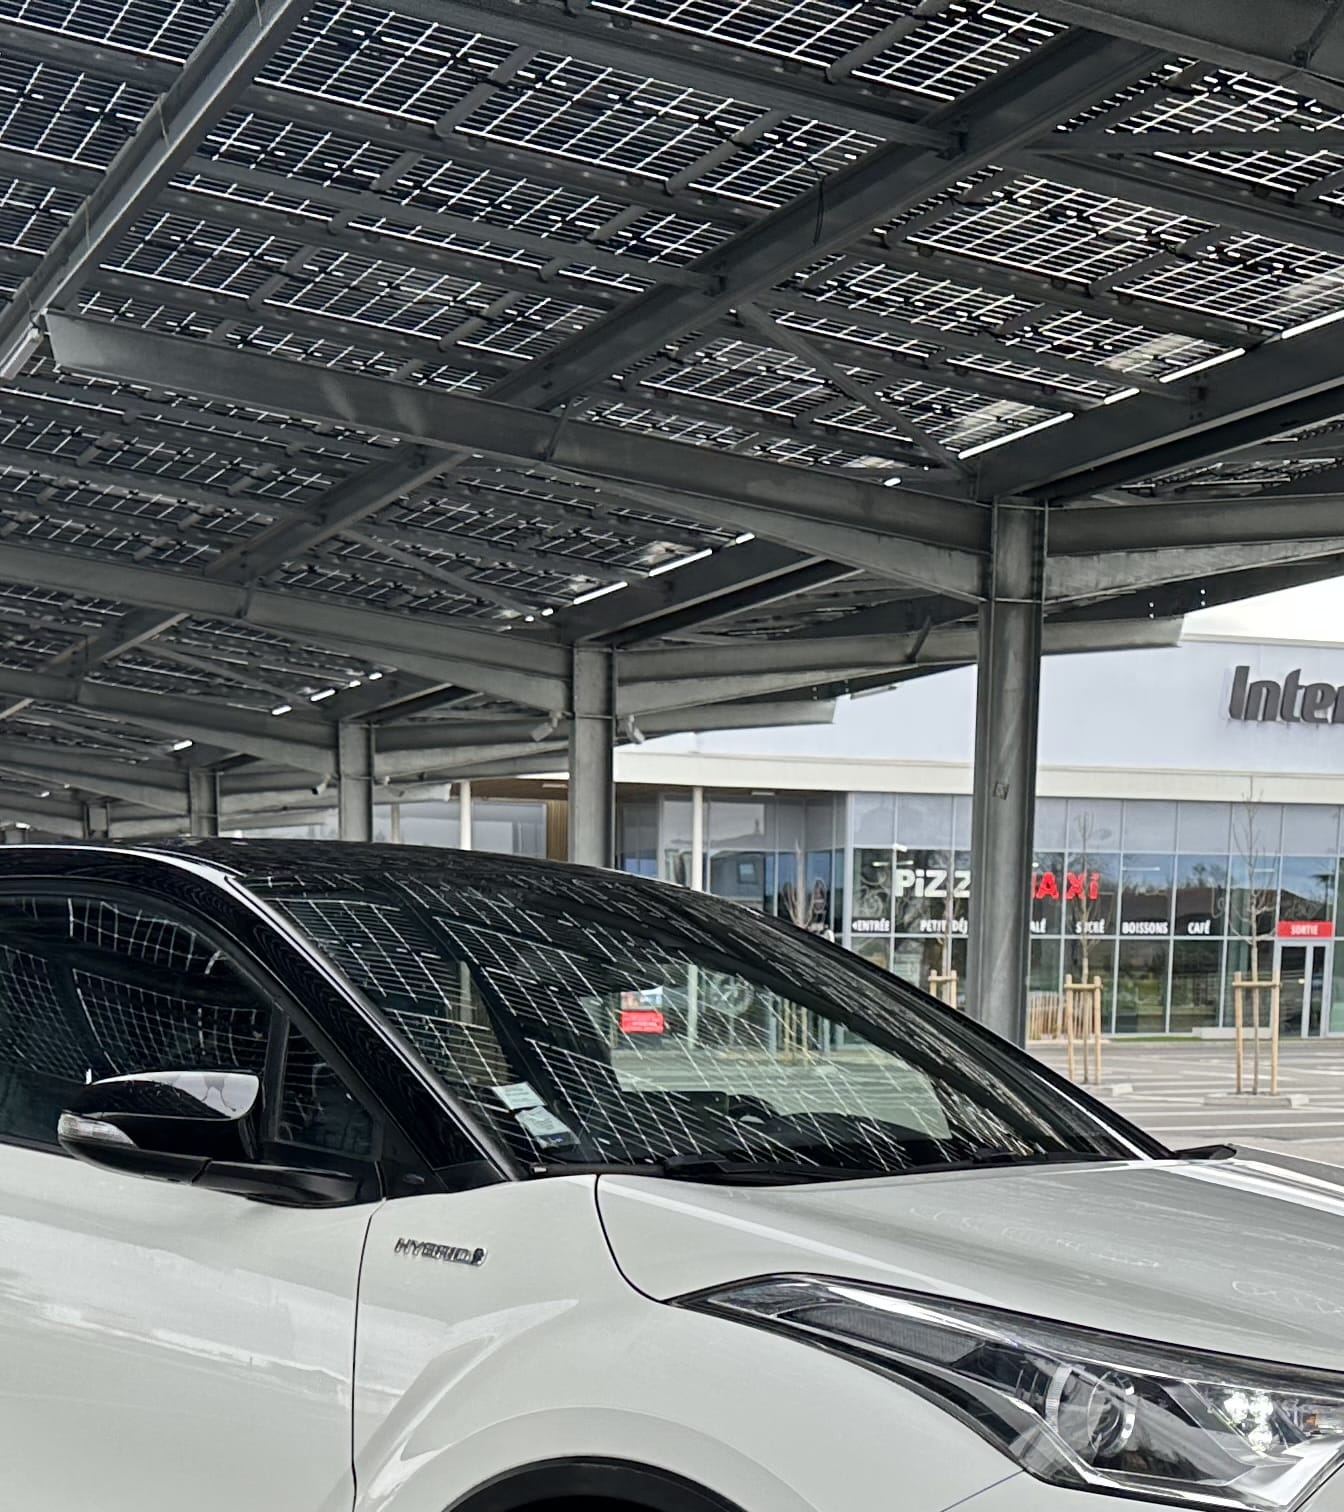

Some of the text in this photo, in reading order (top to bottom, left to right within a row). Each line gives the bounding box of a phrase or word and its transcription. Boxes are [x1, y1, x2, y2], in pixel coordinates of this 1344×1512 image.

[895, 868, 1100, 901] PiZZ AXi
[1031, 917, 1047, 934] ALÉ
[1121, 921, 1168, 935] BOISSONS
[1187, 919, 1211, 935] CAFÉ
[394, 1238, 472, 1264] HYBRID
